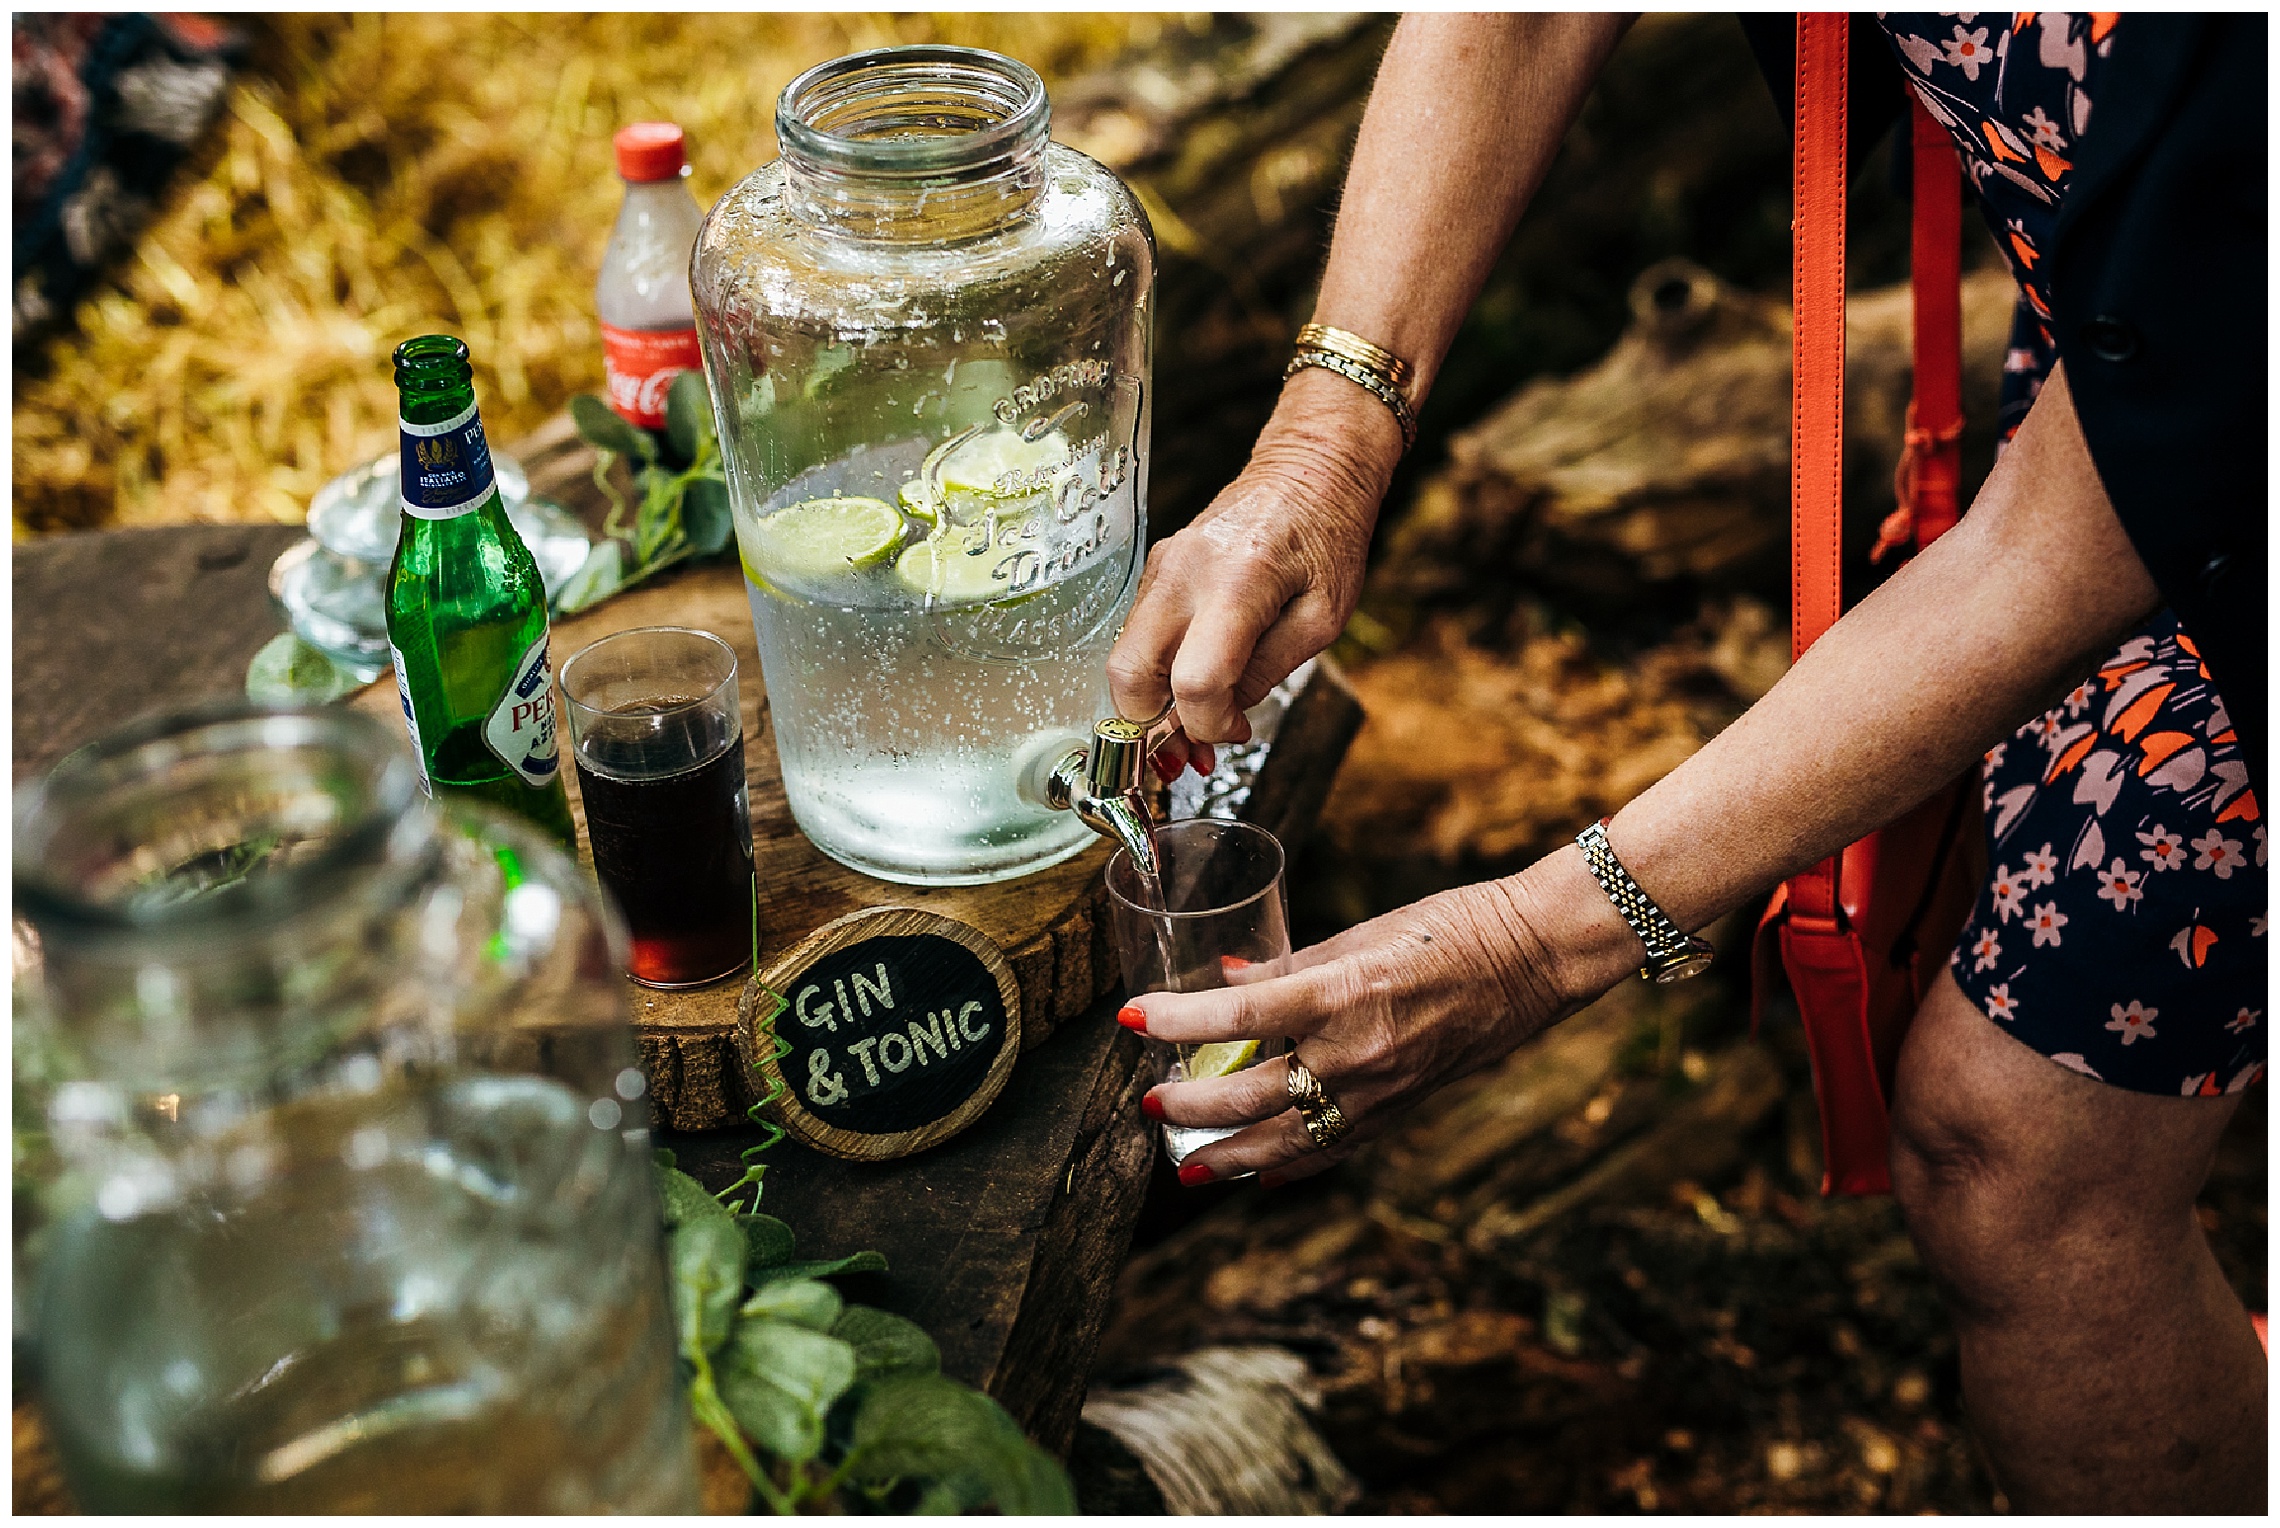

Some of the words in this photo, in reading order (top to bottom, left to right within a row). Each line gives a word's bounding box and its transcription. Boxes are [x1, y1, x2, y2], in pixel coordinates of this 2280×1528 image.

[963, 508, 1041, 556] Ice
[1057, 443, 1128, 525] Cold
[991, 512, 1110, 593] Drink
[795, 962, 895, 1032] GIN
[806, 1048, 849, 1106] &
[847, 1000, 991, 1087] TONIC
